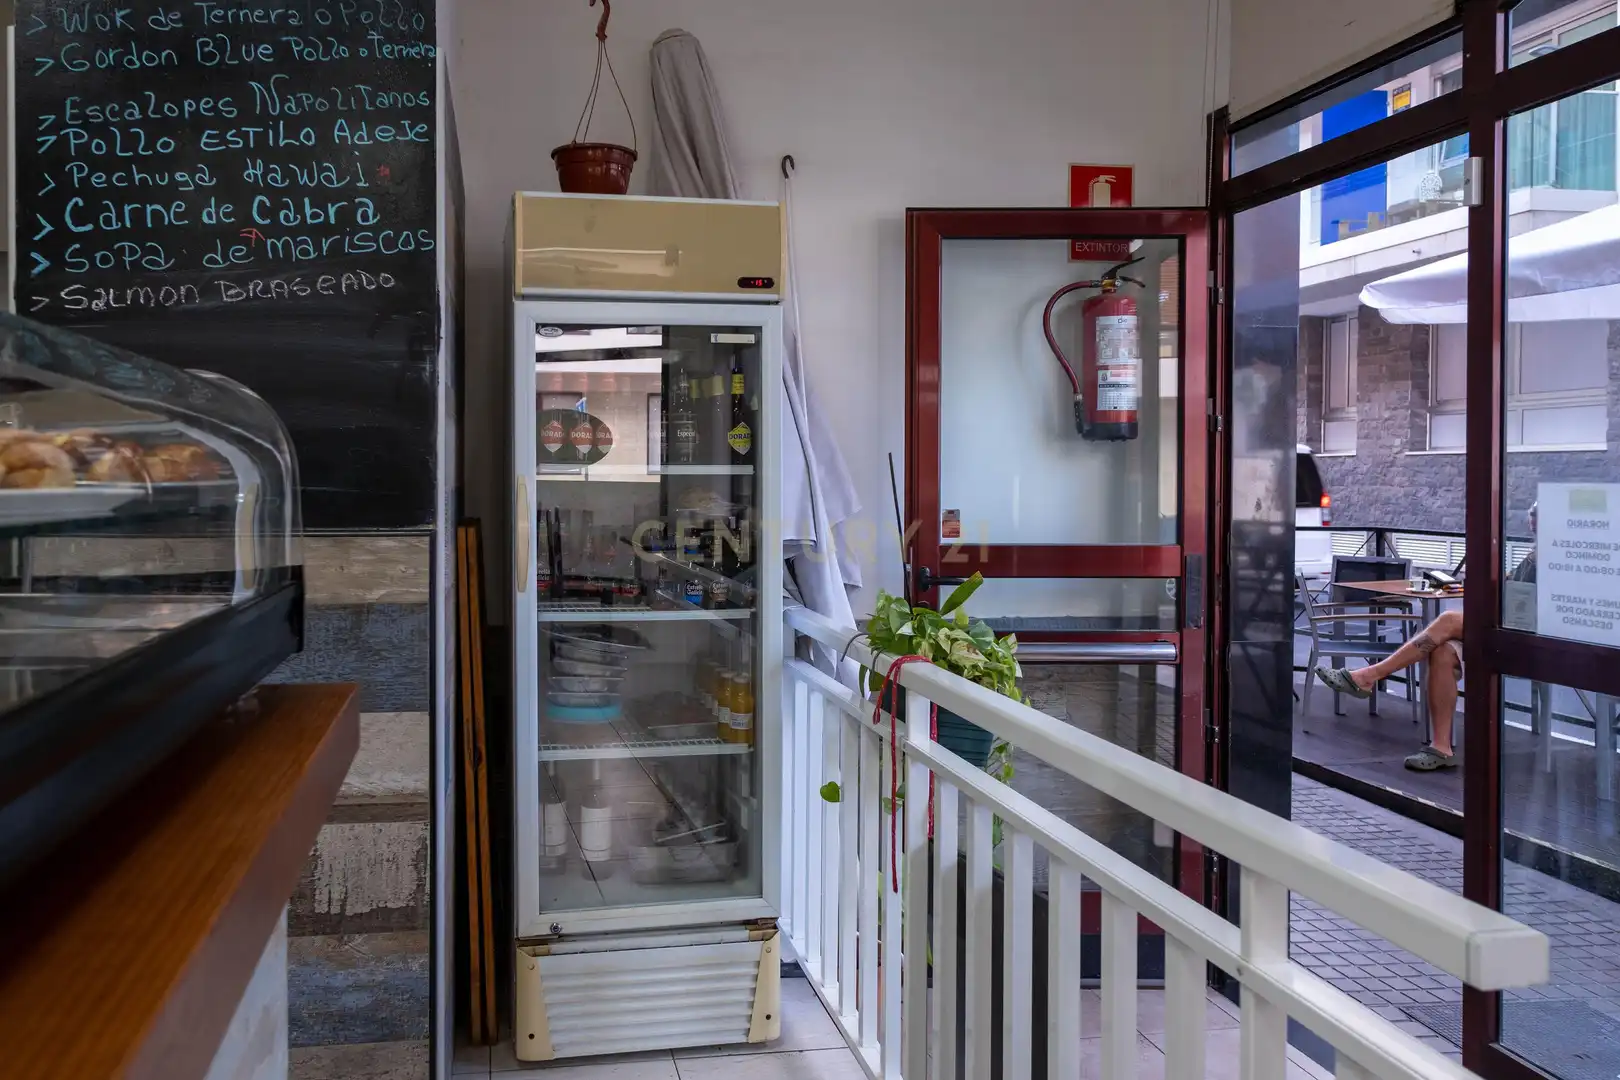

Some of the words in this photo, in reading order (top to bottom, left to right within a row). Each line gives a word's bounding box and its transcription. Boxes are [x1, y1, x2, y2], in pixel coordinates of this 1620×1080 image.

[148, 7, 183, 31] de
[194, 2, 302, 26] Ternera
[340, 0, 425, 30] Pollo
[61, 41, 178, 71] Gordon
[196, 33, 274, 66] Blue
[280, 36, 349, 61] Pollo
[367, 33, 437, 60] Ternera
[65, 91, 238, 124] Escalopes
[60, 127, 176, 156] Pollo
[65, 161, 217, 191] Pechuga
[243, 151, 369, 188] Hawai
[64, 196, 189, 232] Carne
[202, 196, 236, 225] de
[252, 194, 381, 226] Cabra
[202, 238, 254, 268] de
[266, 228, 434, 262] mariscos
[1075, 242, 1128, 253] EXTINTOR
